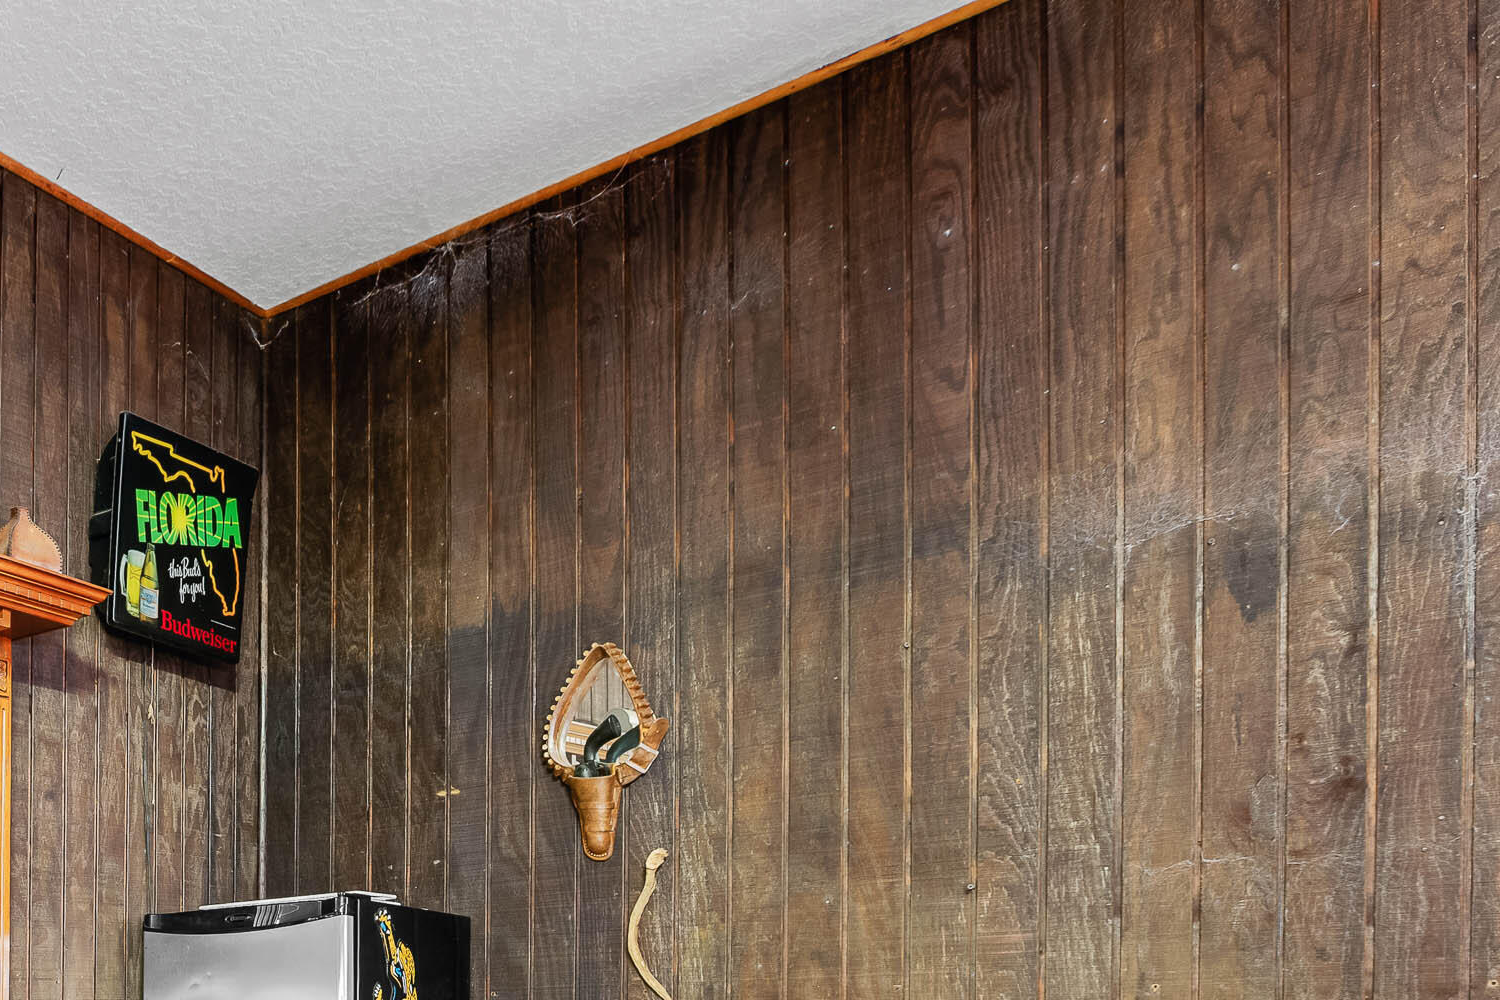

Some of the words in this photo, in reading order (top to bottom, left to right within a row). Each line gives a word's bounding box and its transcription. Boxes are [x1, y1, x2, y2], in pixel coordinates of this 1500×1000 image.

[135, 488, 242, 549] FLORIDA
[168, 558, 182, 578] this
[179, 577, 190, 604] for
[190, 576, 206, 603] you!
[160, 609, 237, 653] Budweiser
